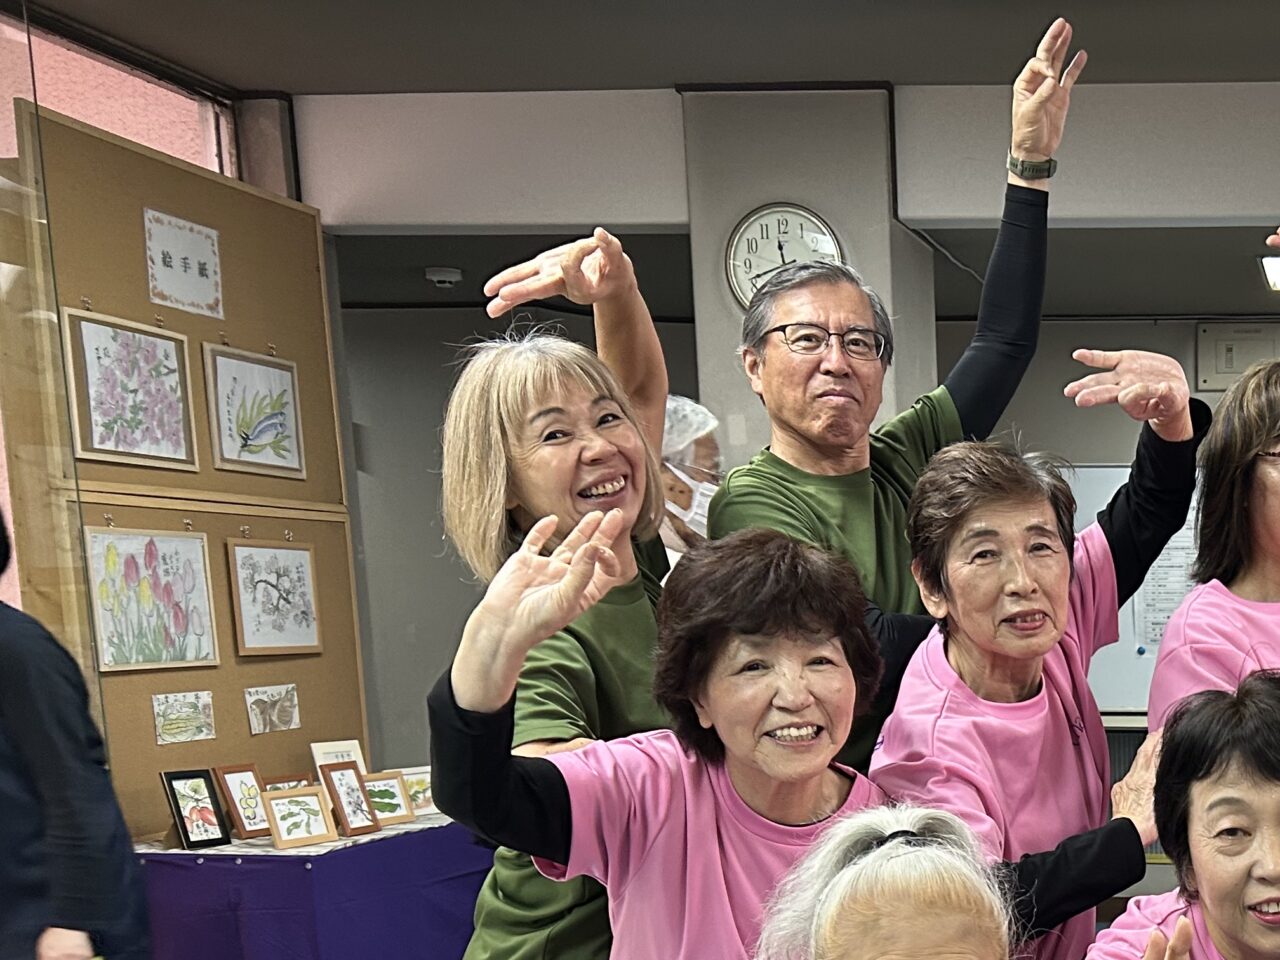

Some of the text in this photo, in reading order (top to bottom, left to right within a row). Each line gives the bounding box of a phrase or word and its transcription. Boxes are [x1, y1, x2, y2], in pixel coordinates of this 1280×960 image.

[759, 222, 769, 240] 11
[777, 218, 789, 235] 12
[799, 222, 805, 239] 1
[746, 237, 758, 254] 10
[811, 236, 819, 253] 2
[161, 249, 209, 279] 絵手紙
[743, 257, 752, 275] 9
